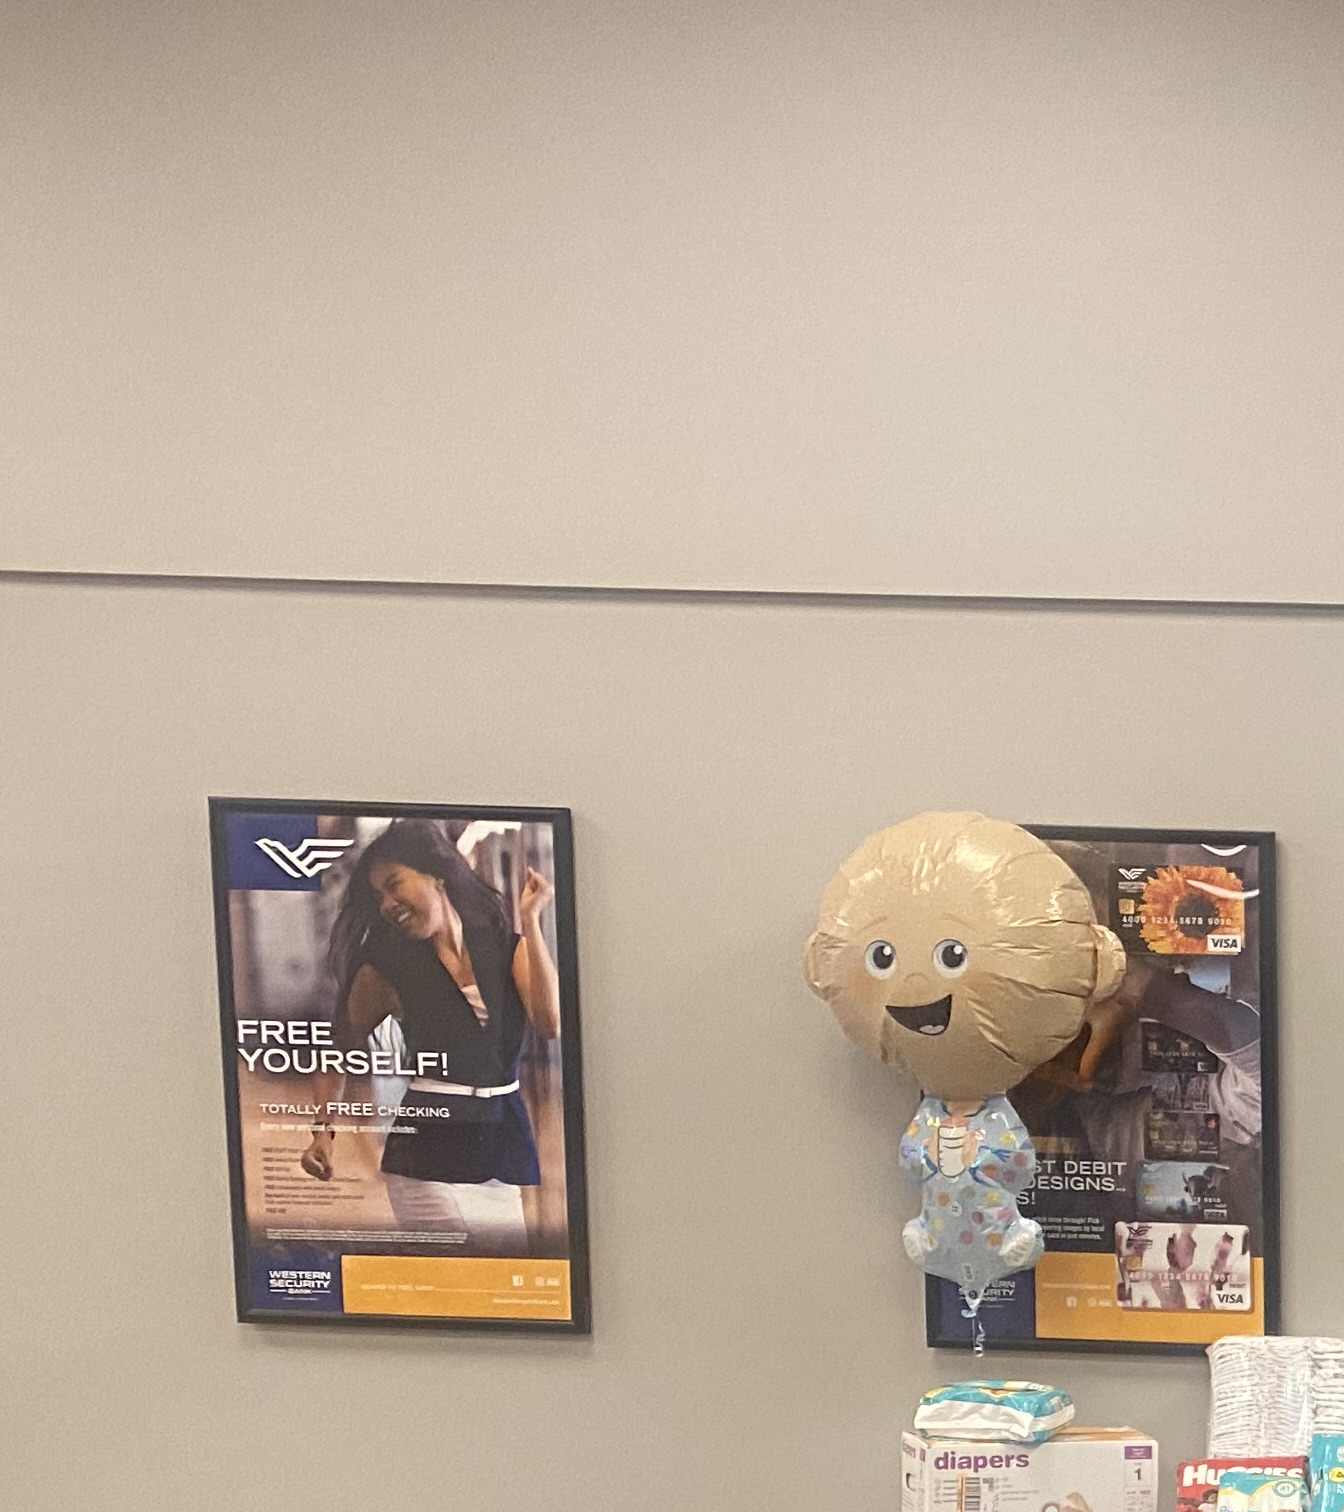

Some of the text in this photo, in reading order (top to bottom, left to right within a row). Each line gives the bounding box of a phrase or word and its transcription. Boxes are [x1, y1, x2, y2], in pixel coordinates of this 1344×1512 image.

[1211, 938, 1238, 949] VISA
[237, 1020, 333, 1045] FREE
[238, 1049, 448, 1076] YOURSELF!
[260, 1102, 450, 1118] TOTALLY FREE CHECKING
[1064, 1161, 1127, 1176] DEBIT
[269, 1271, 330, 1280] WESTERN
[269, 1279, 330, 1289] SECURITY
[1217, 1294, 1243, 1304] VISA
[934, 1451, 1030, 1473] diapers
[1134, 1468, 1142, 1481] 1
